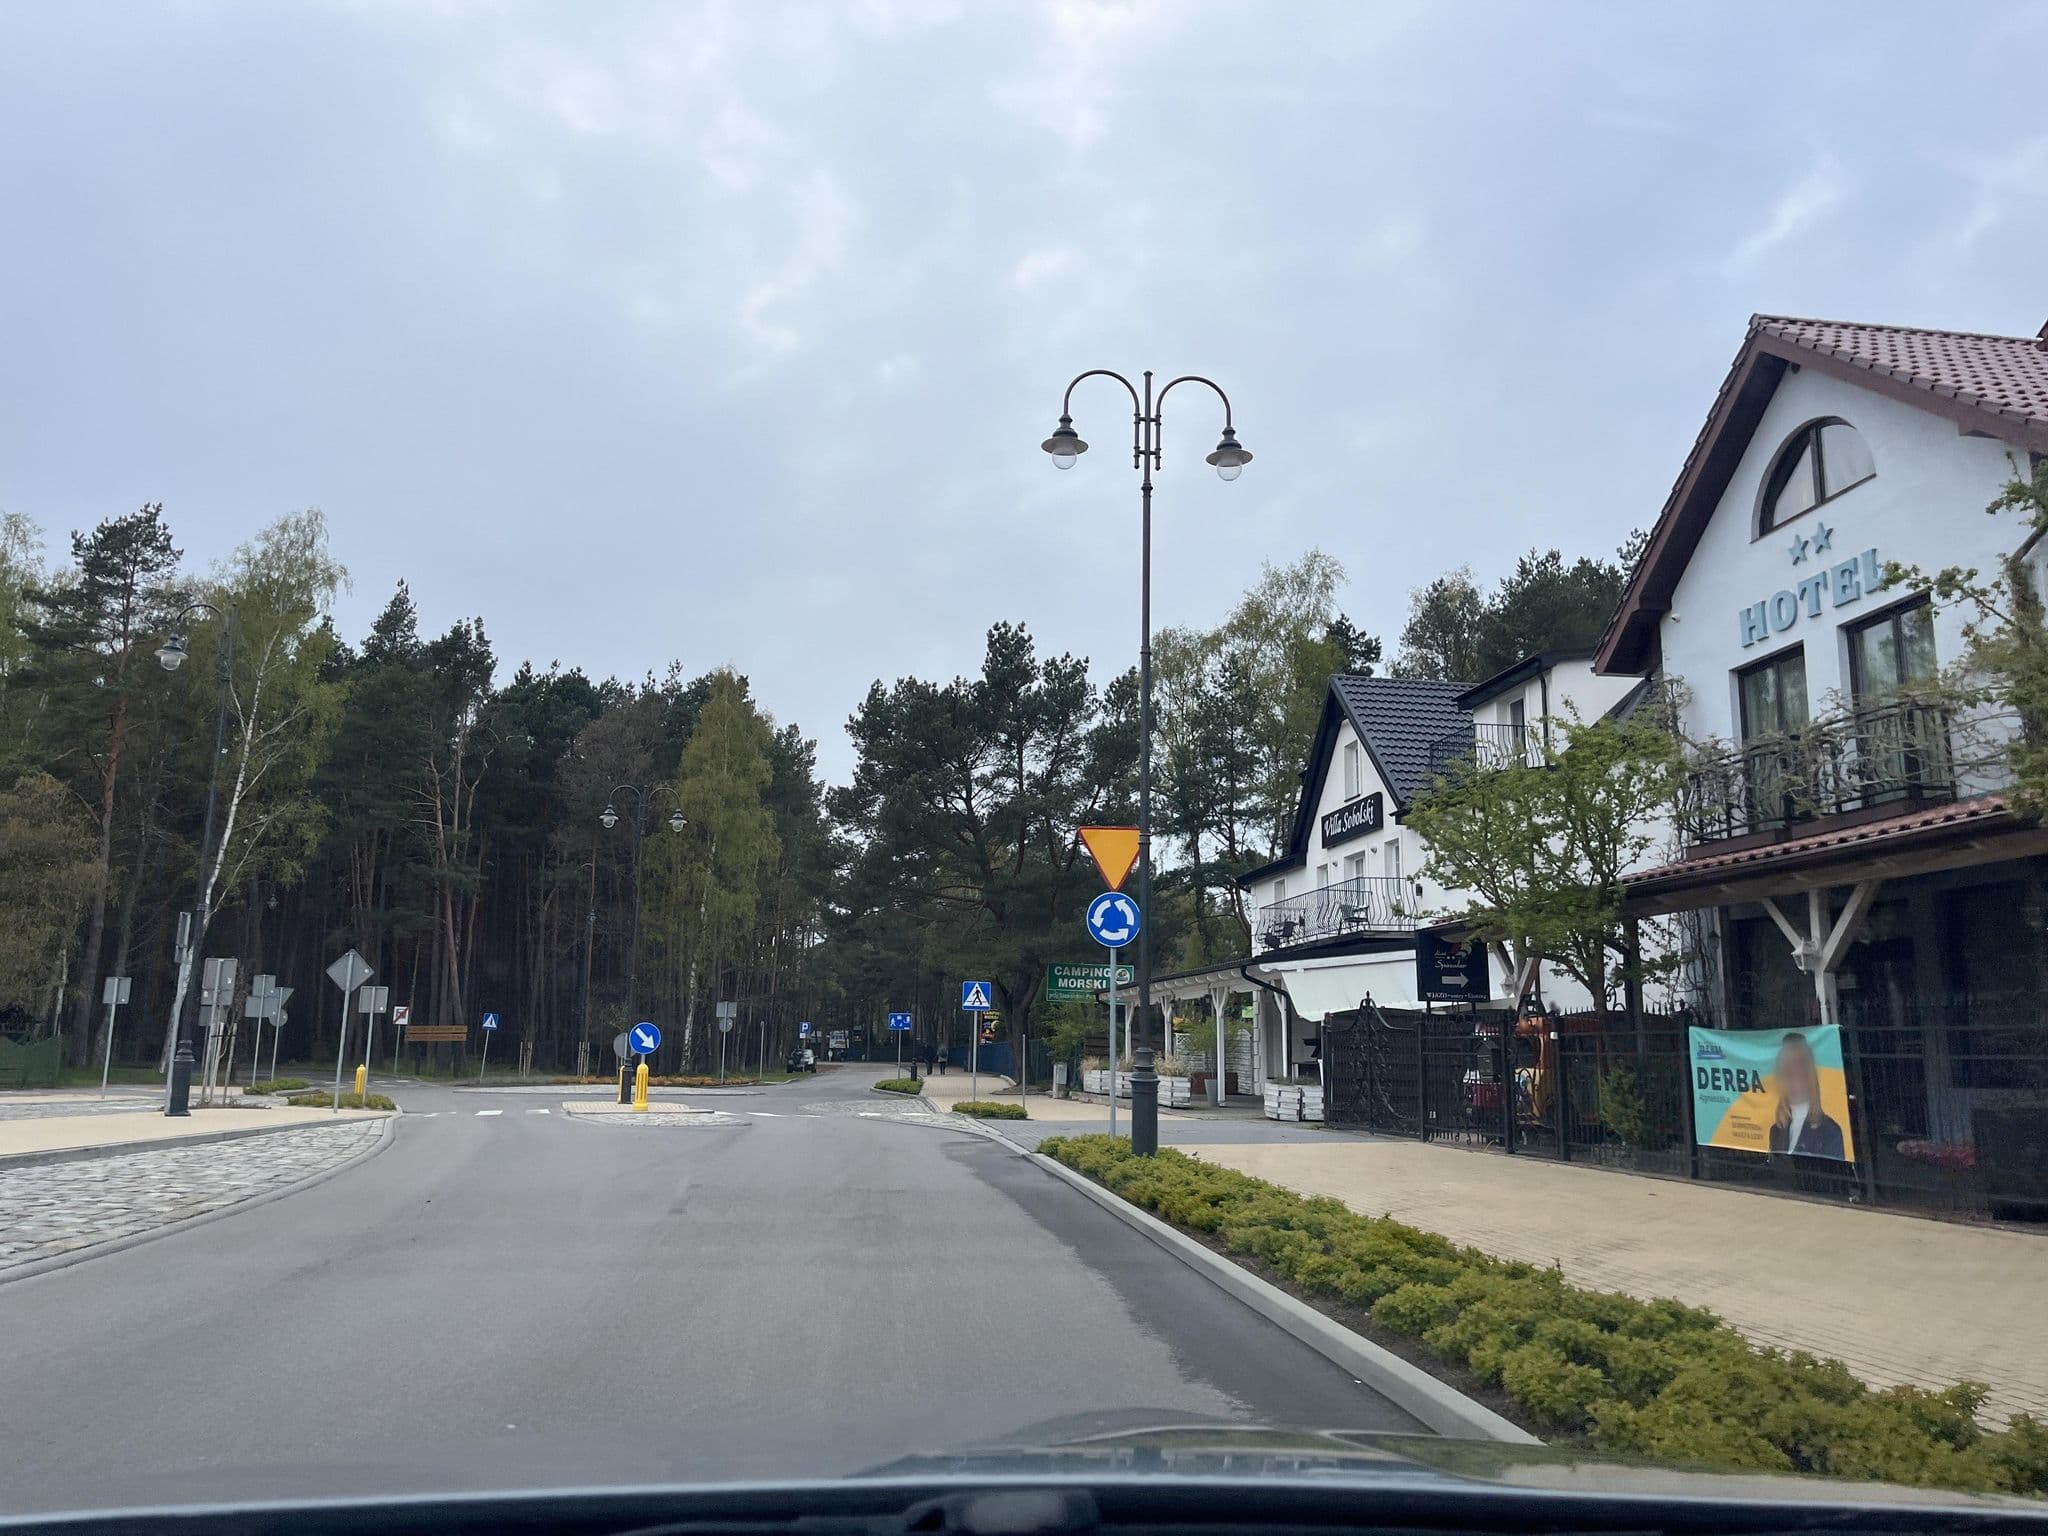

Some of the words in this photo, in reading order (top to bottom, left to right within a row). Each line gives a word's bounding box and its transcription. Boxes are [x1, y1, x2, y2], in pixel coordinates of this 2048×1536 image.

[1738, 548, 1884, 648] HOTEL
[1324, 813, 1342, 837] Villa
[1342, 799, 1374, 832] Sobolski
[1054, 966, 1112, 977] CAMPING
[1058, 978, 1107, 989] MORSKI
[802, 1023, 809, 1032] P
[1697, 1067, 1766, 1093] DERBA
